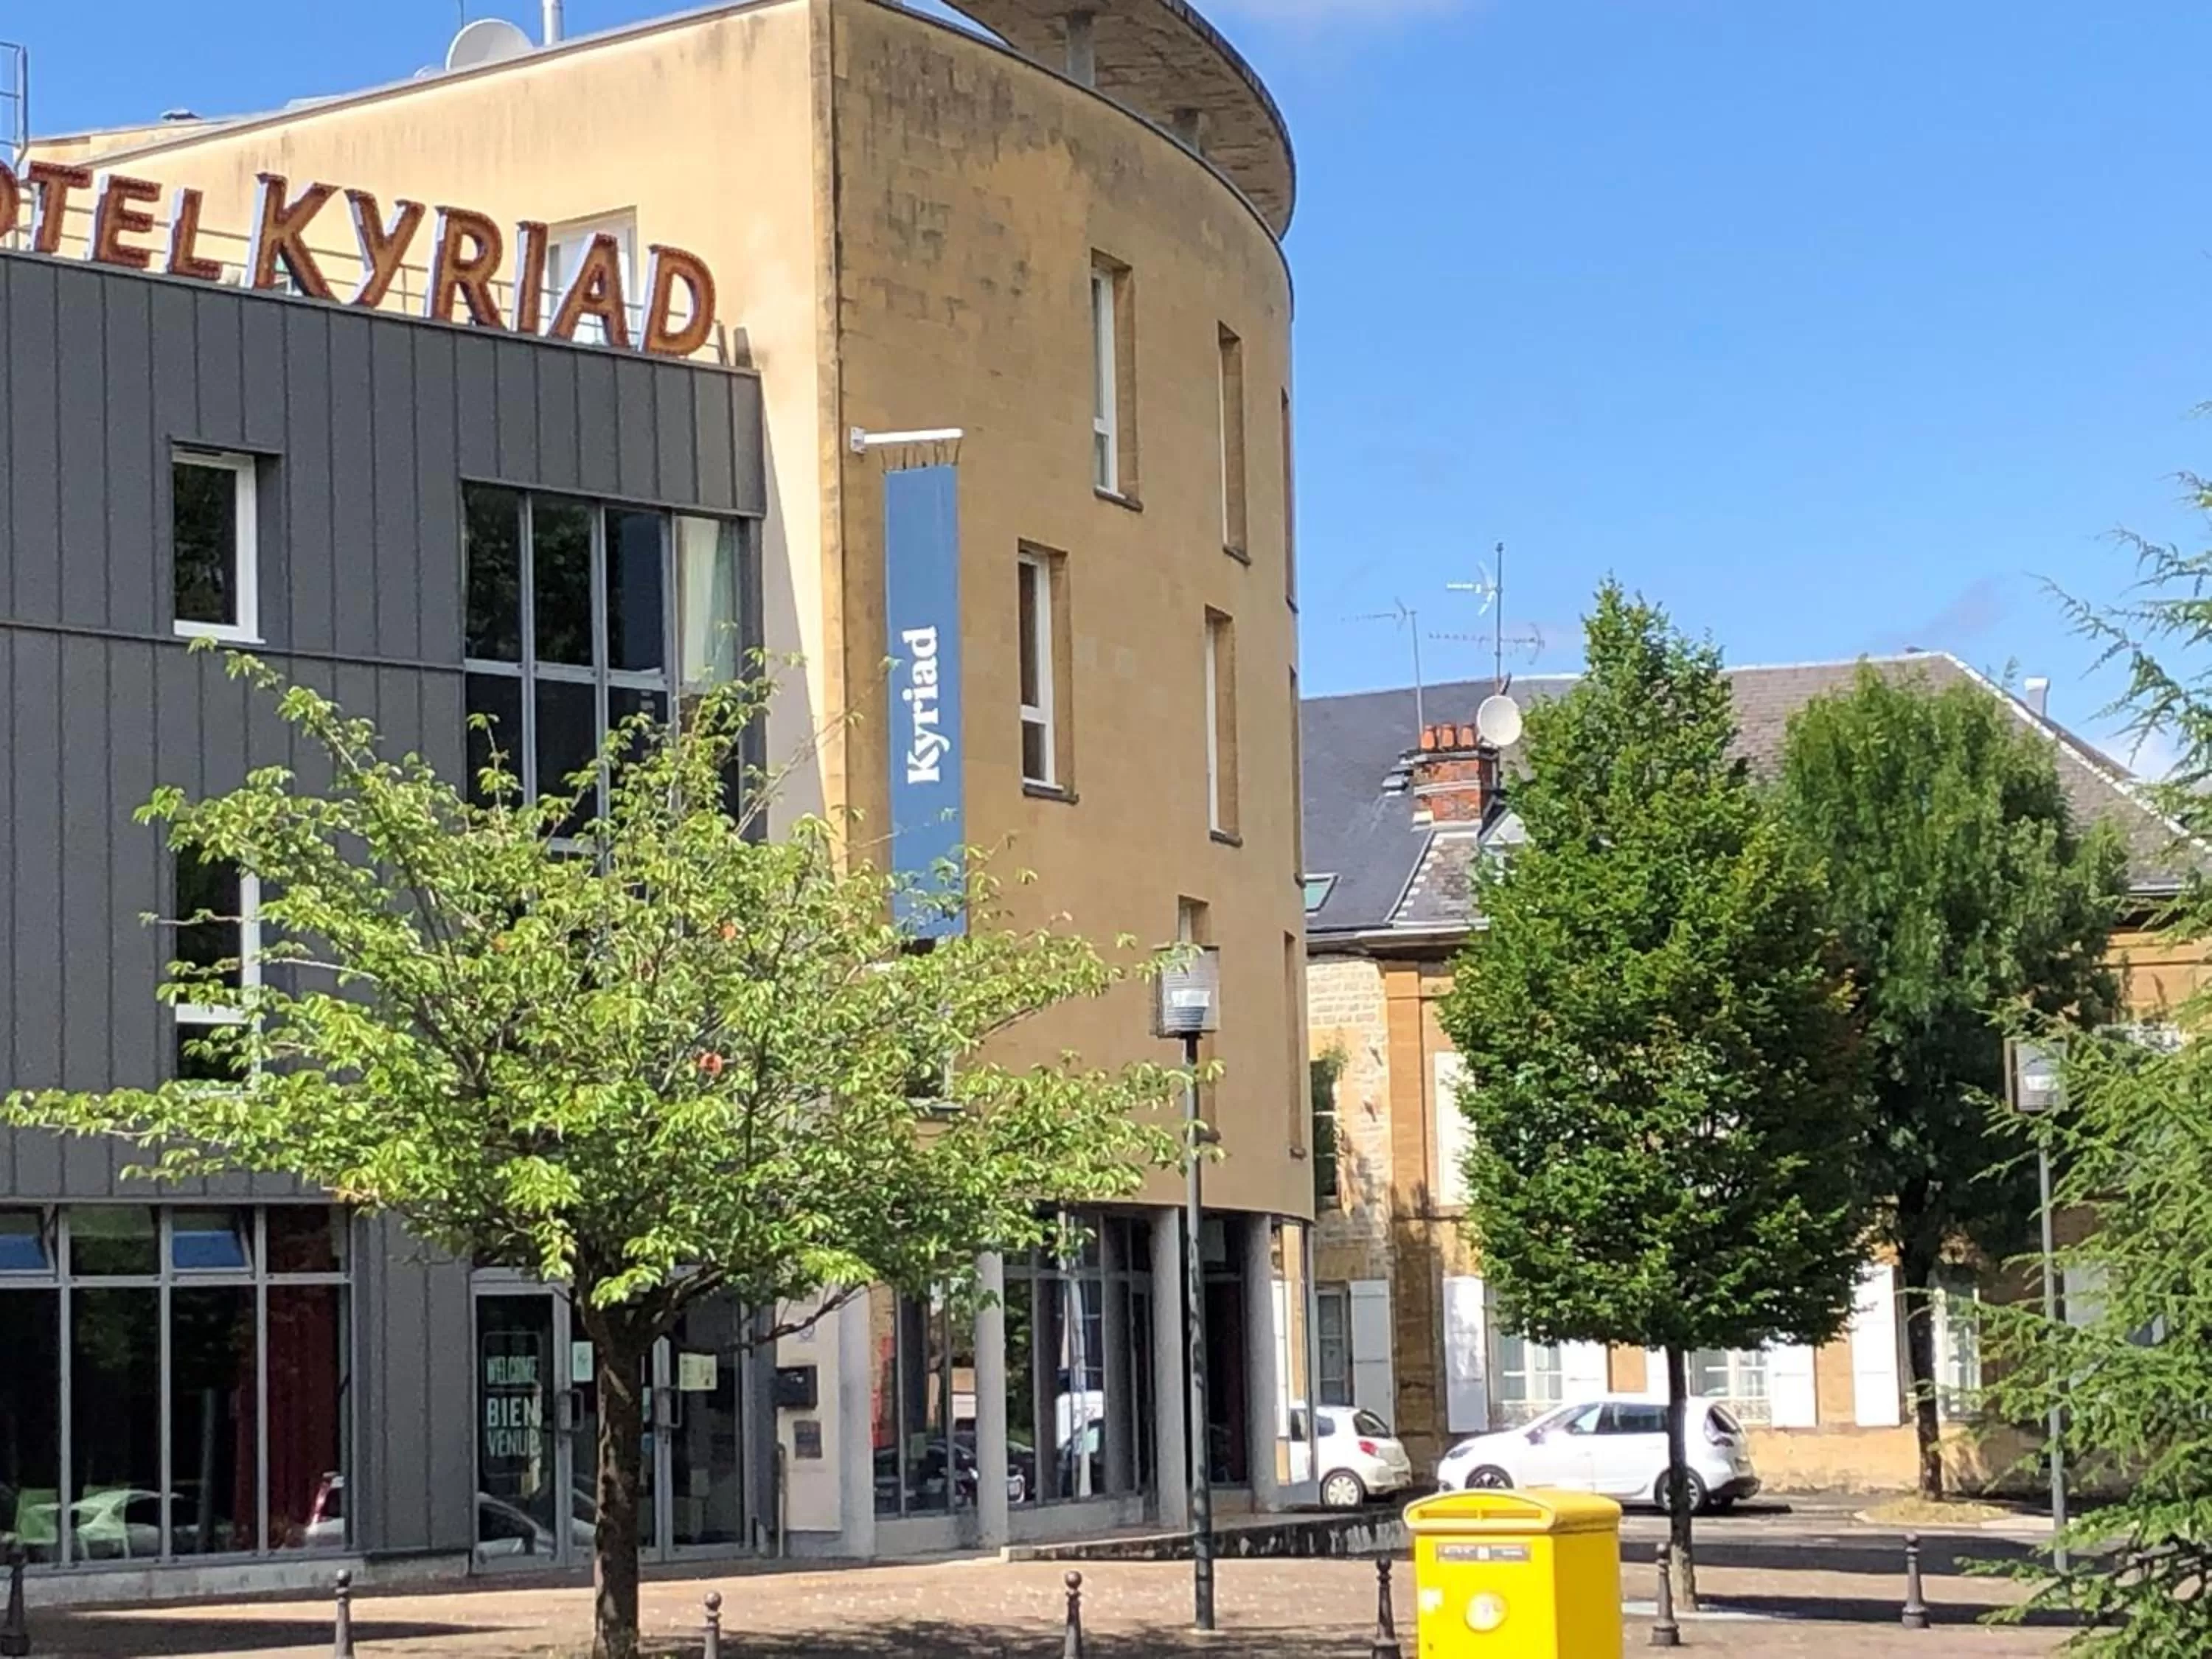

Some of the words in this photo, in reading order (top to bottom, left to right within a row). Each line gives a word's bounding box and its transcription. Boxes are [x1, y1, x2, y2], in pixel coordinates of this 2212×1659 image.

[249, 172, 716, 356] KYRIAD
[902, 625, 950, 785] Kyriad
[487, 1397, 542, 1427] BIEN
